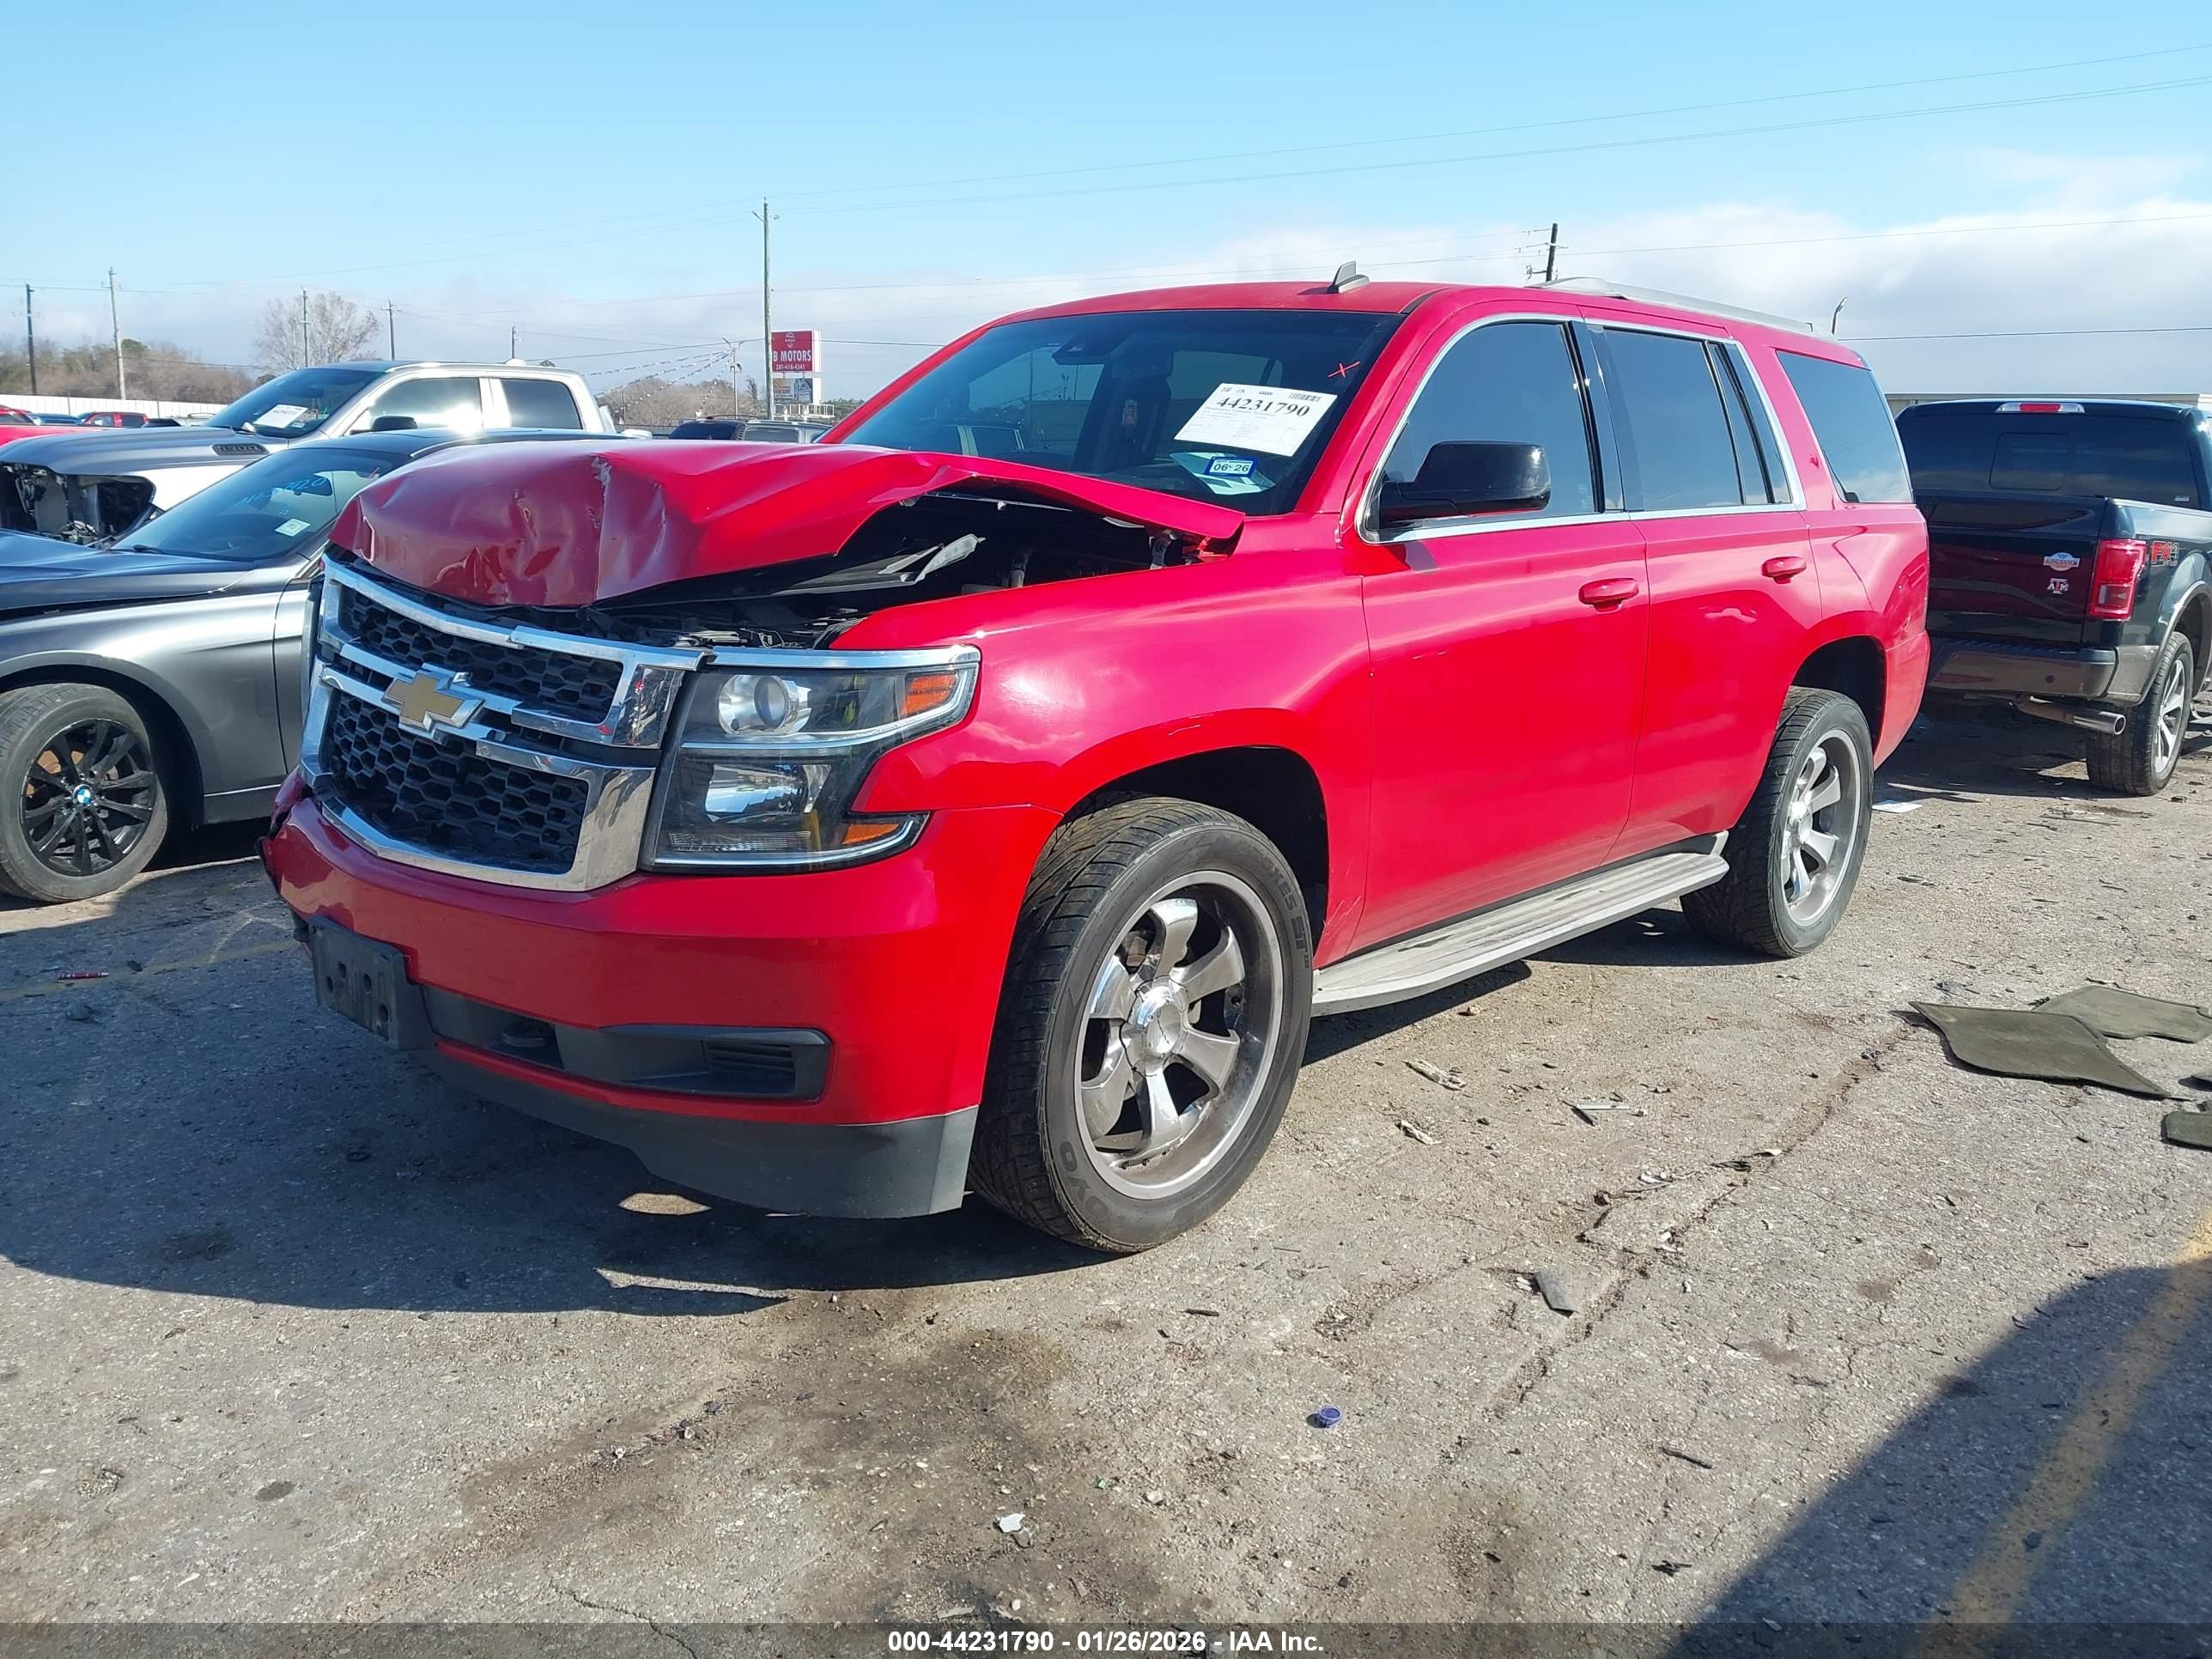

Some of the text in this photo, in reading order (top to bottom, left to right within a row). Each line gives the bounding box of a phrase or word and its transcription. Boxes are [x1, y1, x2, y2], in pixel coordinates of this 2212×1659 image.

[781, 349, 811, 362] MOTORS
[1217, 397, 1310, 417] 44231790
[2151, 541, 2179, 567] FX4
